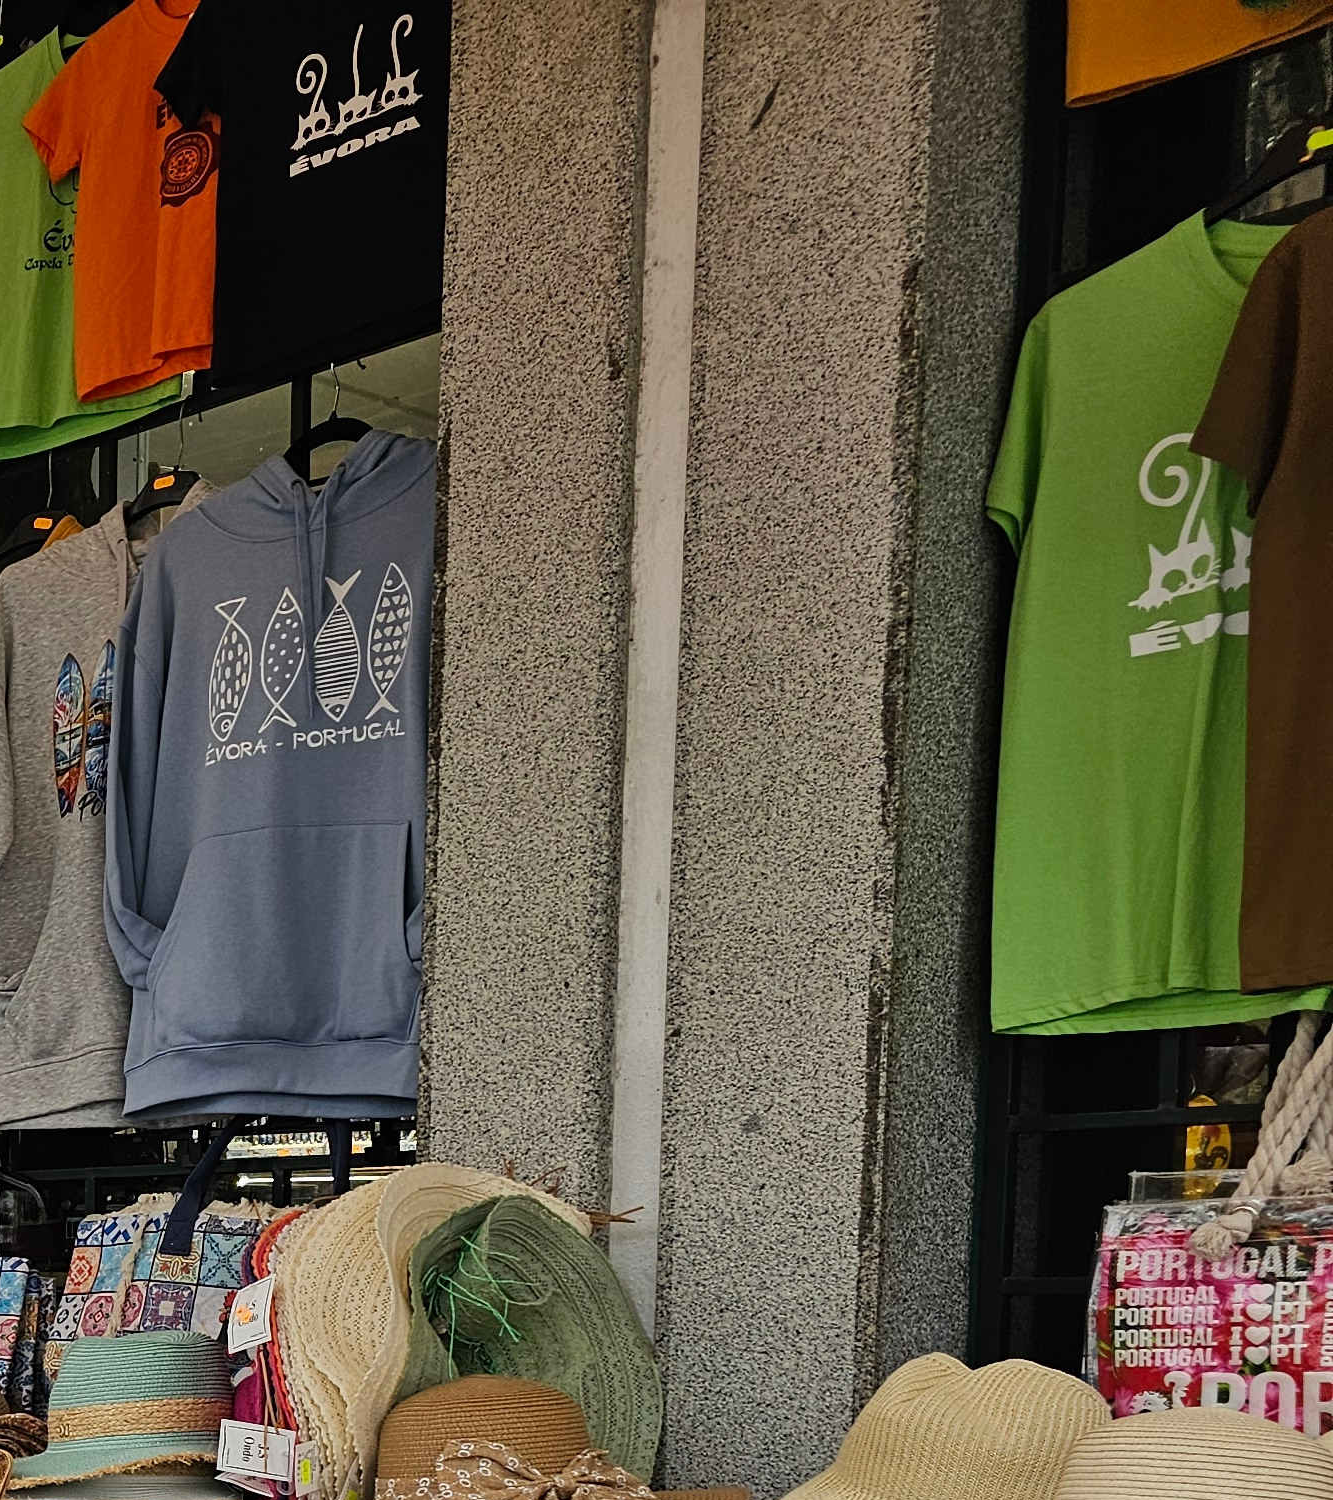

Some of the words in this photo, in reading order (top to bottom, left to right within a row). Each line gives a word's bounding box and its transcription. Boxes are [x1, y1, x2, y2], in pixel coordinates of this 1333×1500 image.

[290, 114, 421, 178] ÉVORA
[24, 257, 63, 272] Capela
[205, 739, 267, 768] ÉVORA
[292, 722, 406, 753] PORTUGAL
[1116, 1243, 1309, 1283] PORTUGAL
[1114, 1286, 1220, 1307] PORTUGAL
[1274, 1281, 1312, 1304] PT
[1114, 1307, 1220, 1327] PORTUGAL
[1272, 1301, 1312, 1323] PT
[1114, 1326, 1219, 1348] PORTUGAL
[1271, 1324, 1310, 1347] PT
[1114, 1347, 1218, 1368] PORTUGAL
[1270, 1344, 1309, 1365] PT
[242, 1436, 255, 1462] Ondo
